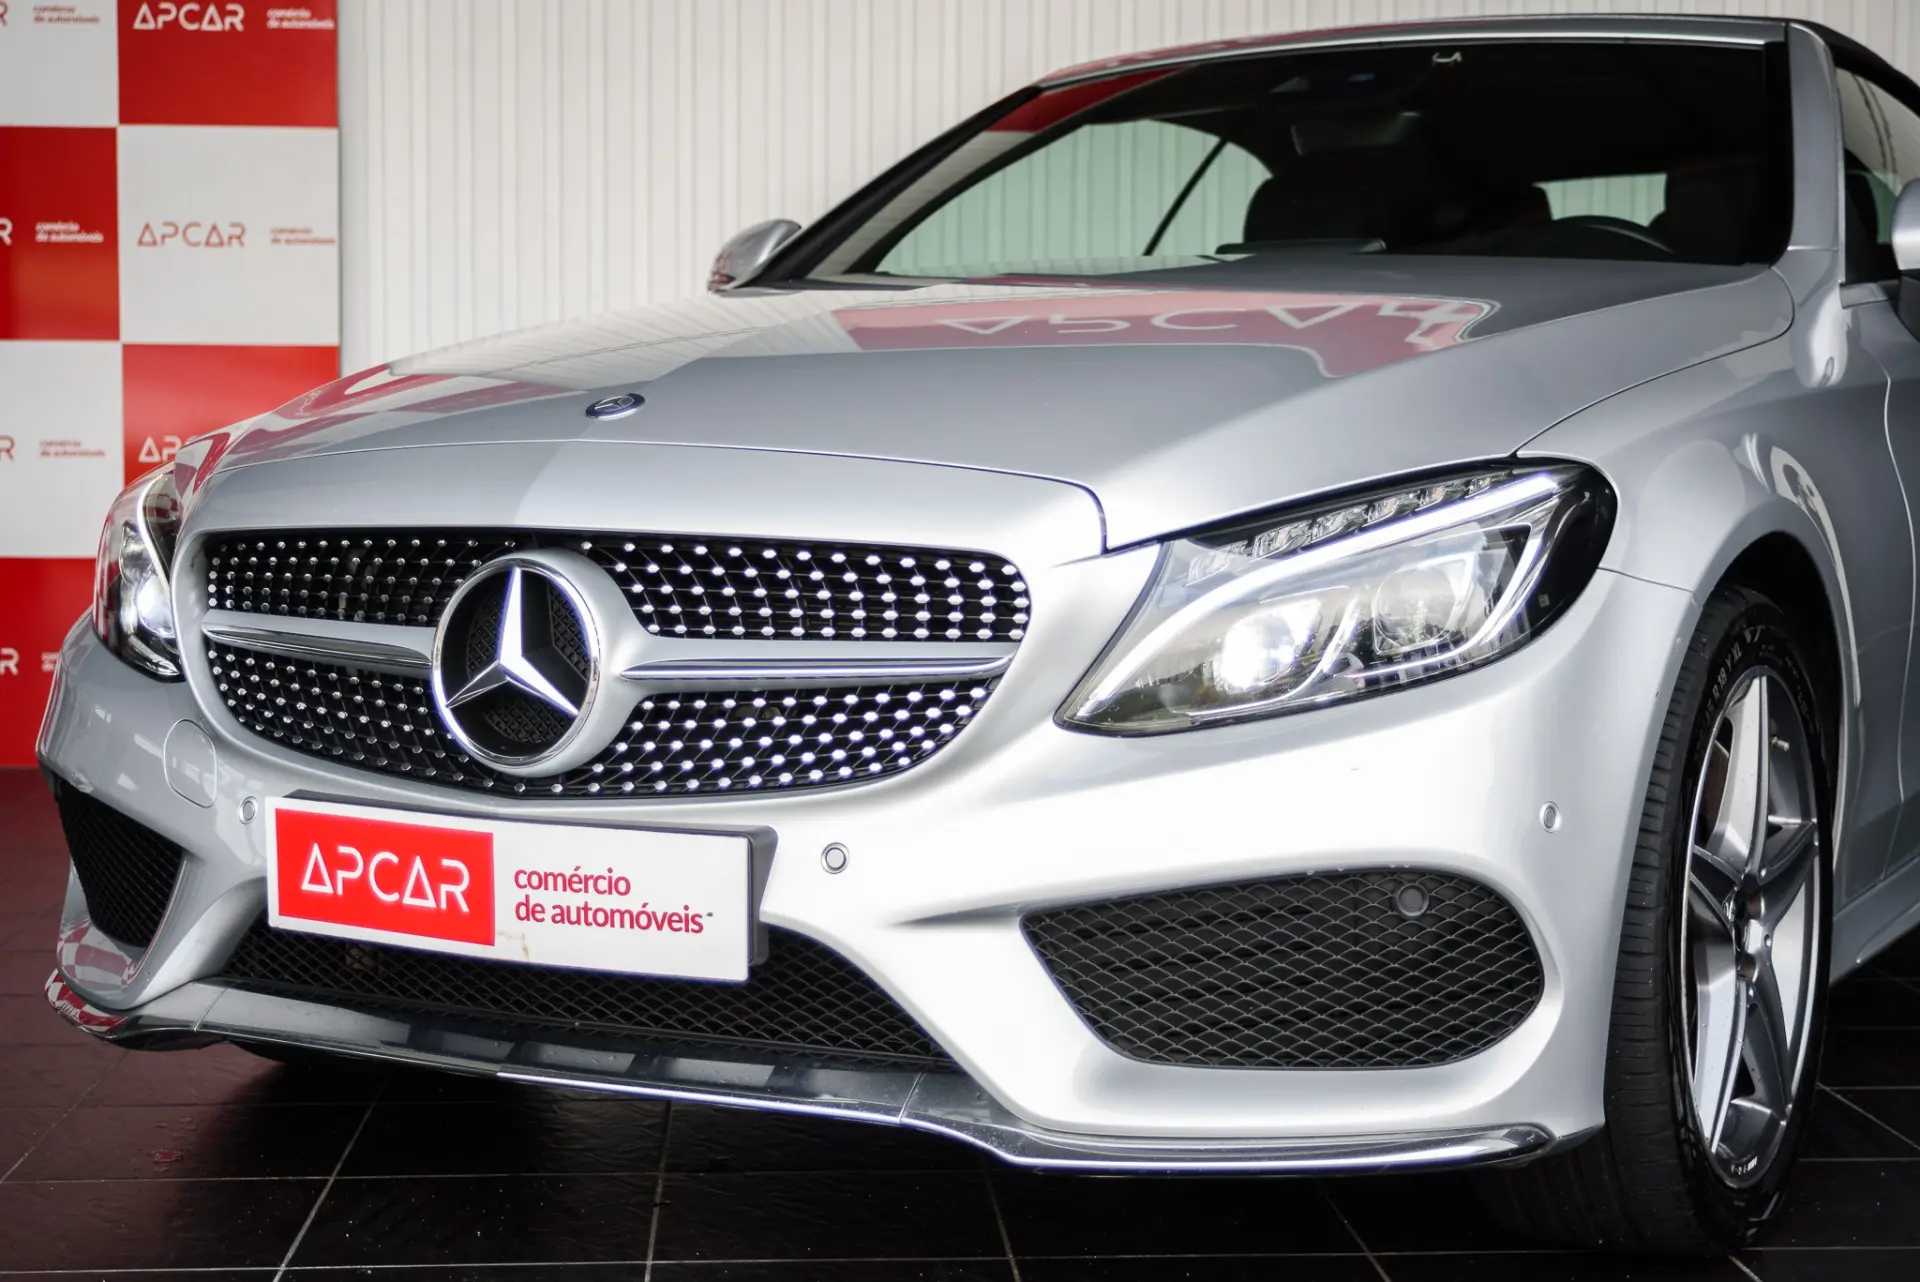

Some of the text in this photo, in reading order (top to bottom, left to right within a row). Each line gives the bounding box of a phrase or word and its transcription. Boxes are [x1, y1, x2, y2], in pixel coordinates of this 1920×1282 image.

[133, 2, 245, 31] APCAR
[136, 222, 246, 247] APCAR
[301, 843, 470, 913] APCAR
[514, 866, 631, 896] comércio
[515, 894, 704, 934] de automóveis
